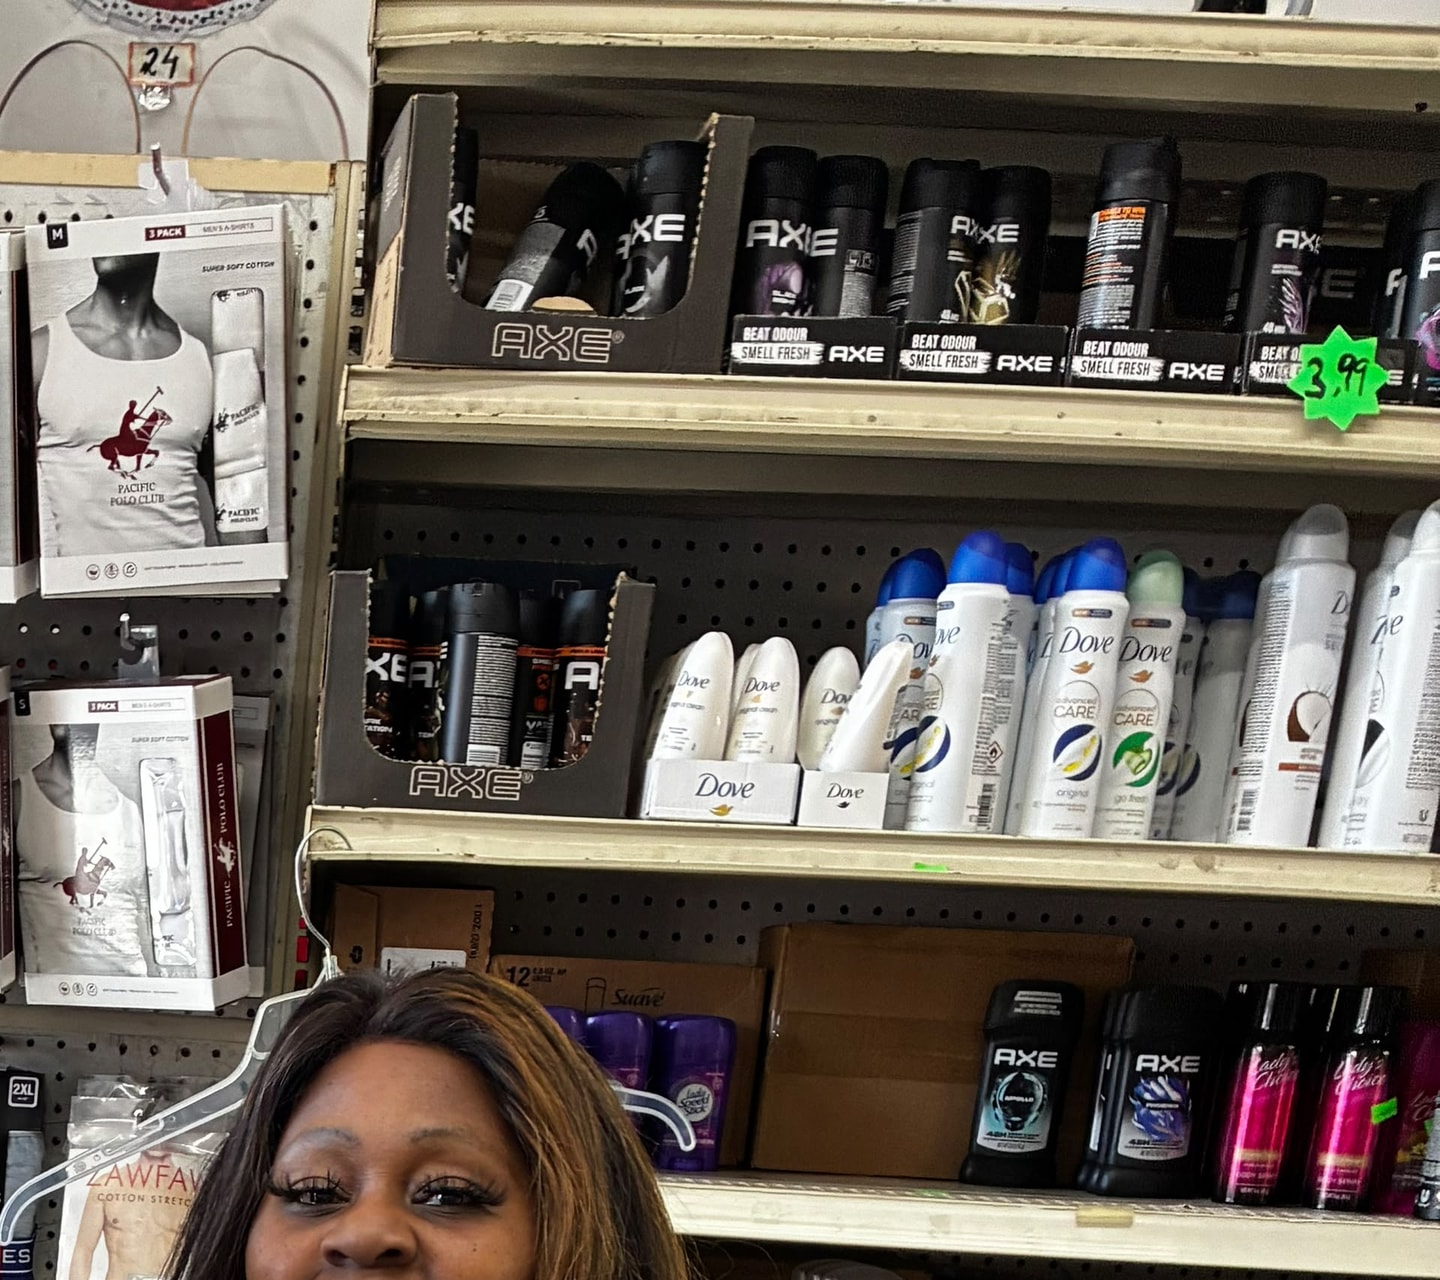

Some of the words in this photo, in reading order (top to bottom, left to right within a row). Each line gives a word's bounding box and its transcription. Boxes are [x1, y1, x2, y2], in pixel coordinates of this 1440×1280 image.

[138, 47, 181, 79] 24
[52, 227, 63, 241] M
[156, 228, 183, 239] PACK
[743, 327, 769, 342] BEAT
[772, 327, 808, 342] ODOUR
[912, 334, 938, 350] BEAT
[941, 334, 976, 350] ODOUR
[741, 344, 776, 360] SMELL
[778, 344, 810, 360] FRESH
[829, 345, 884, 362] AXE
[1083, 340, 1109, 356] BEAT
[1112, 341, 1149, 357] ODOUR
[909, 352, 943, 369] SMELL
[945, 352, 979, 368] FRESH
[997, 355, 1052, 372] AXE
[1080, 359, 1114, 375] SMELL
[1116, 359, 1151, 376] FRESH
[1169, 362, 1225, 381] AXE
[118, 482, 155, 493] PACIFIC
[110, 495, 136, 506] POLO
[137, 493, 164, 504] CLUB
[1059, 626, 1114, 655] Dove
[1118, 636, 1172, 663] Dove
[677, 670, 710, 689] Dove
[744, 677, 781, 694] Dove
[97, 702, 116, 711] PACK
[1054, 704, 1095, 720] CARE
[1113, 712, 1154, 728] CARE
[695, 772, 755, 799] Dove
[826, 782, 864, 799] Dove
[506, 966, 530, 987] 12
[994, 1049, 1058, 1068] AXE
[1135, 1055, 1201, 1072] AXE
[12, 1083, 35, 1097] 2XL
[97, 1193, 145, 1203] COTTON
